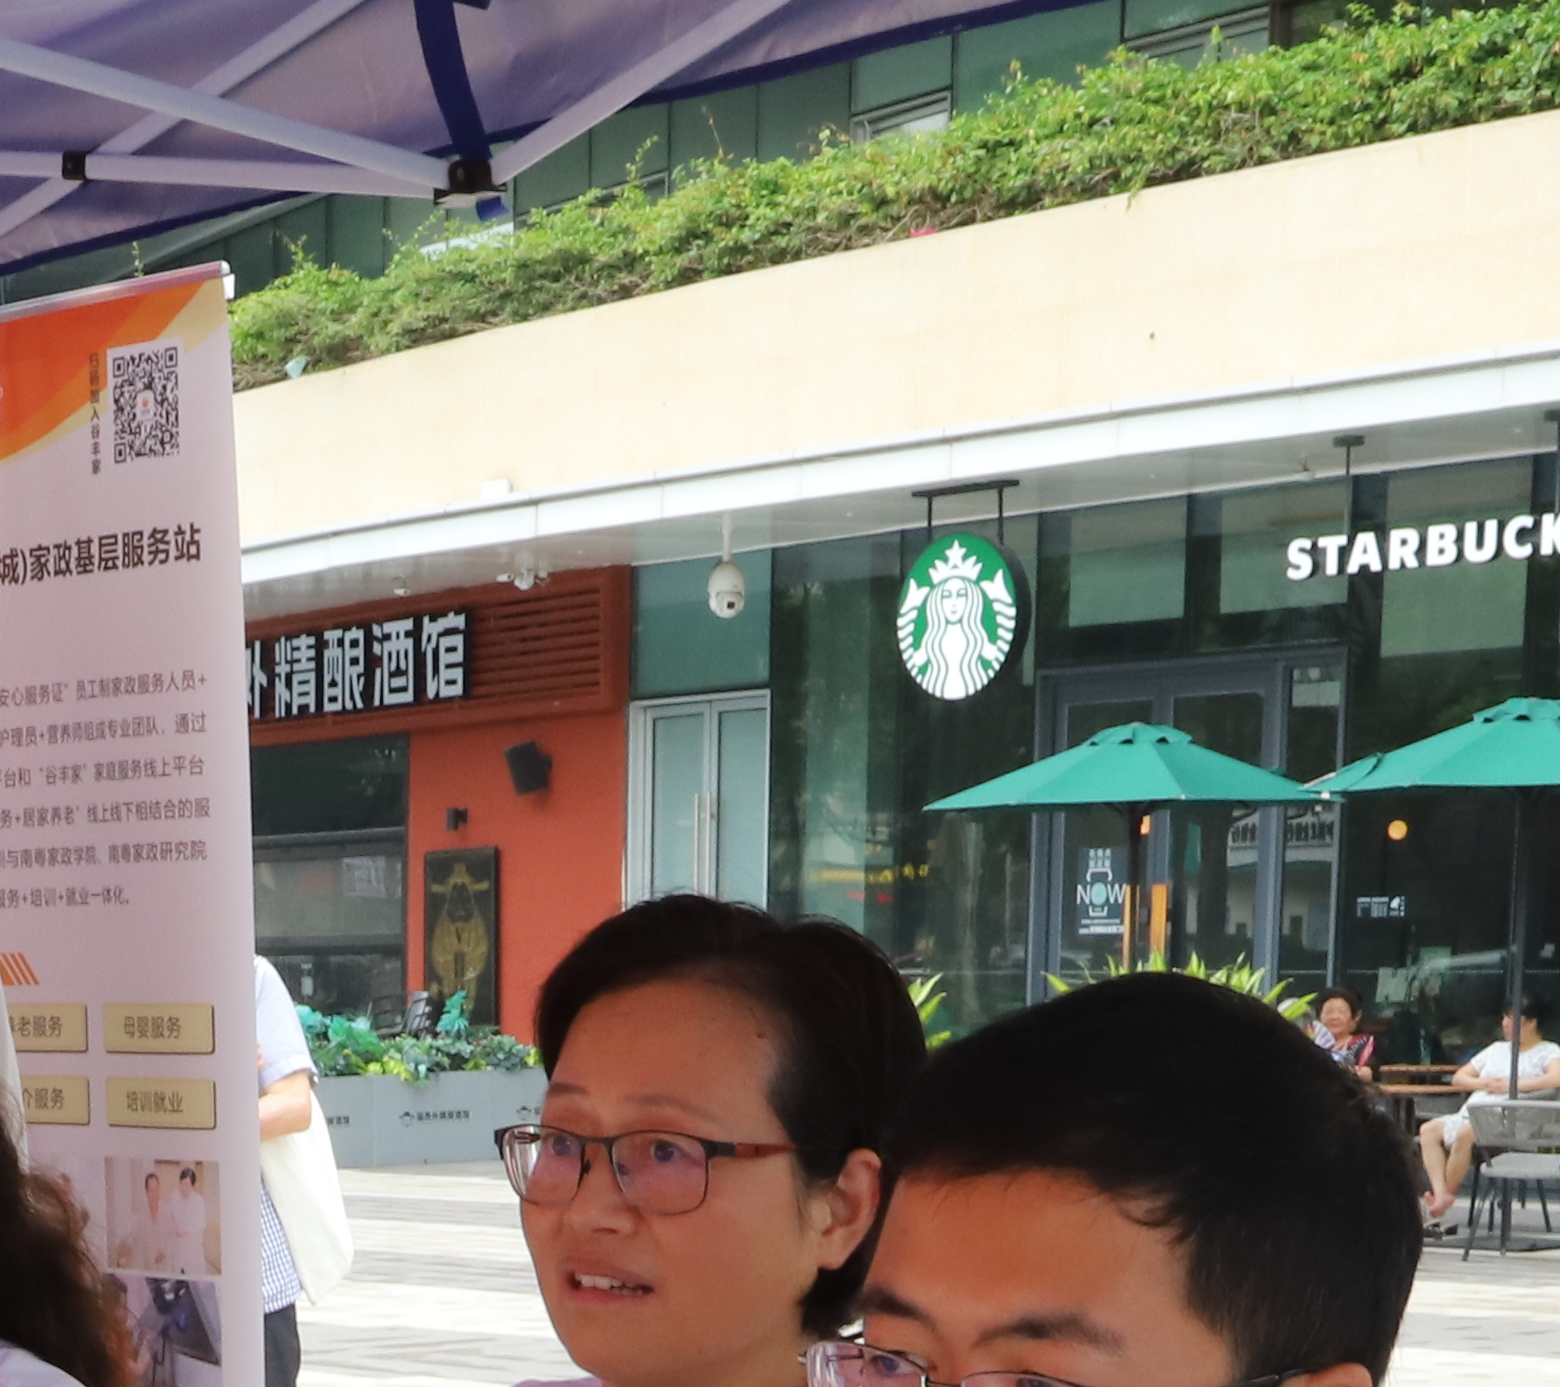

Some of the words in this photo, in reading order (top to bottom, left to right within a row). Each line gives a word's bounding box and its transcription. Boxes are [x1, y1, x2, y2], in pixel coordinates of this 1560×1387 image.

[123, 1014, 182, 1040] 母婴服务
[126, 1090, 184, 1114] 培训就业
